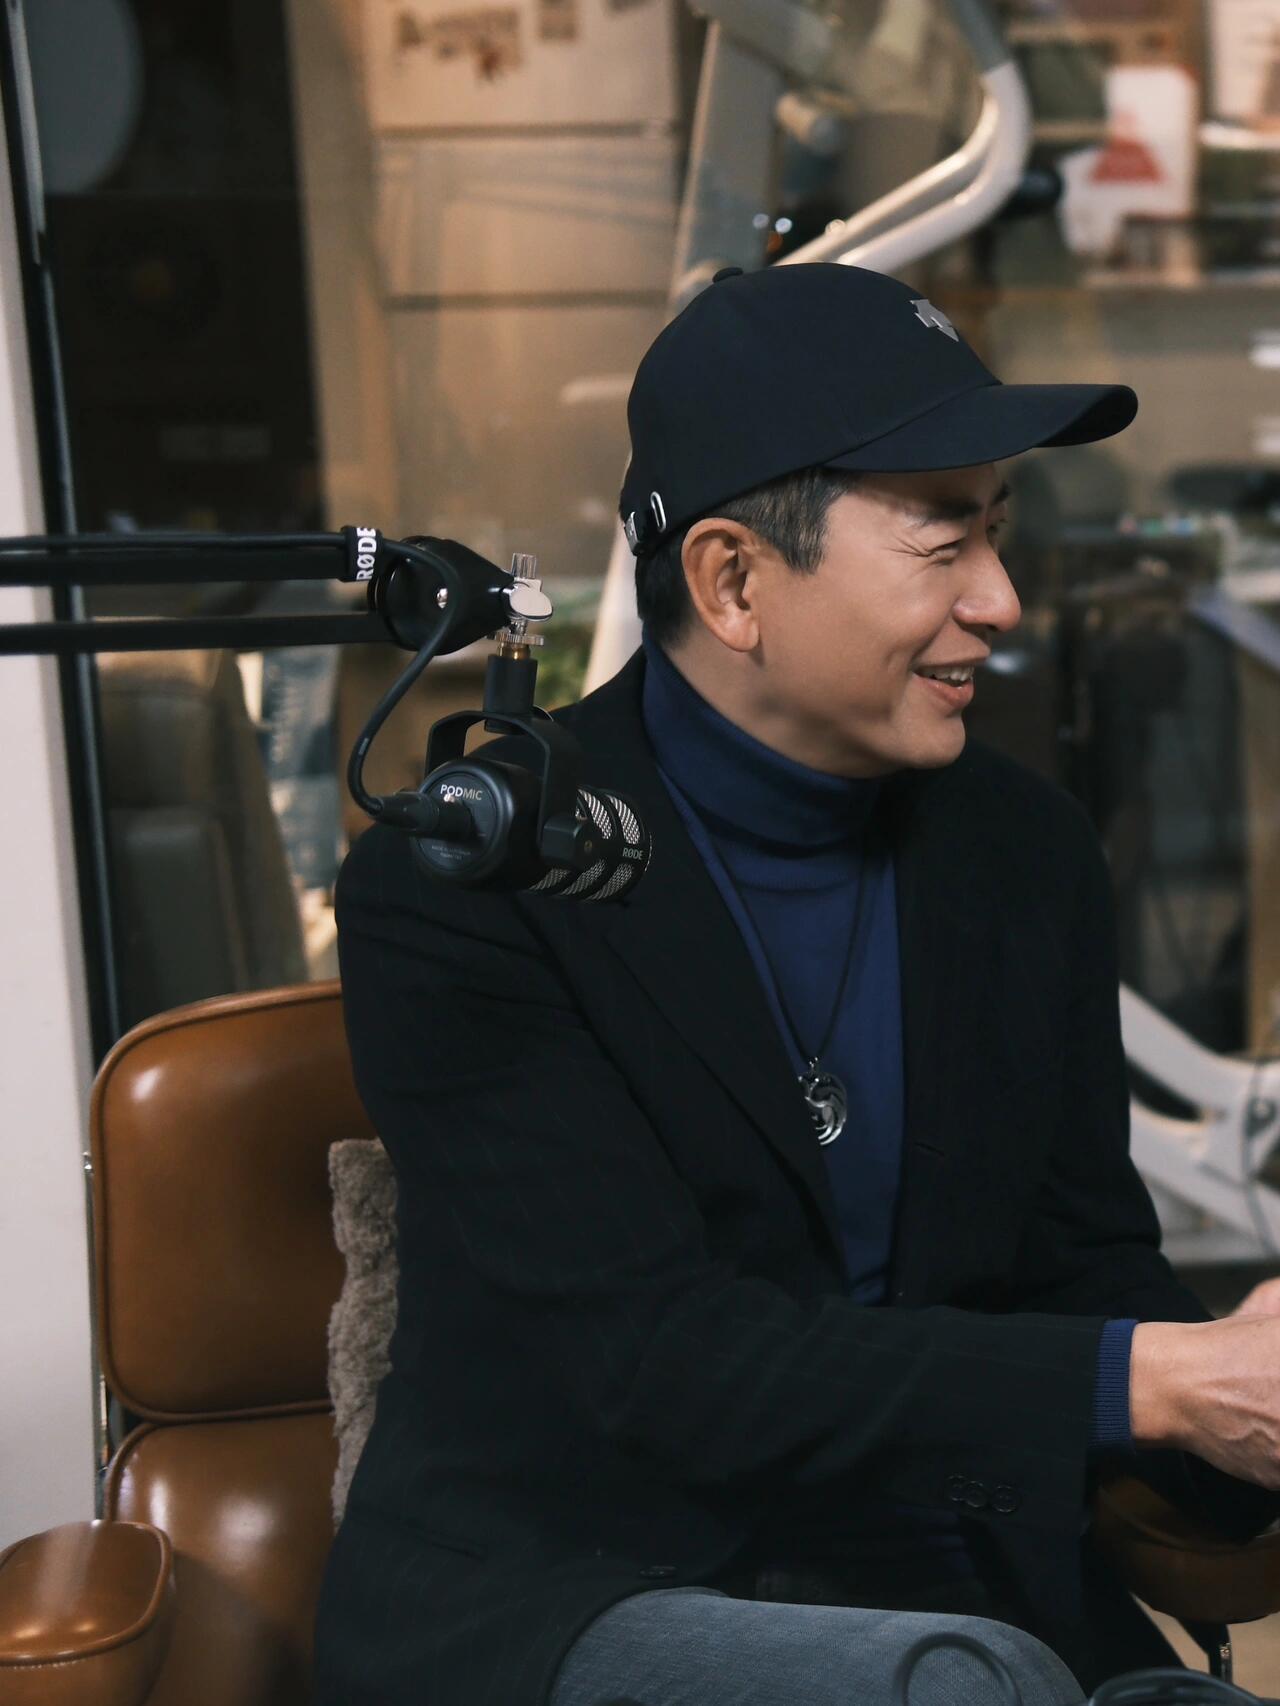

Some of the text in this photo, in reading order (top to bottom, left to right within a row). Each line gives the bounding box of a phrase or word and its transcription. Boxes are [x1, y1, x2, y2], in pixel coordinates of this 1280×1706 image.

[356, 527, 377, 580] RØDE
[440, 784, 483, 801] PODMIC
[622, 847, 644, 861] RØDE
